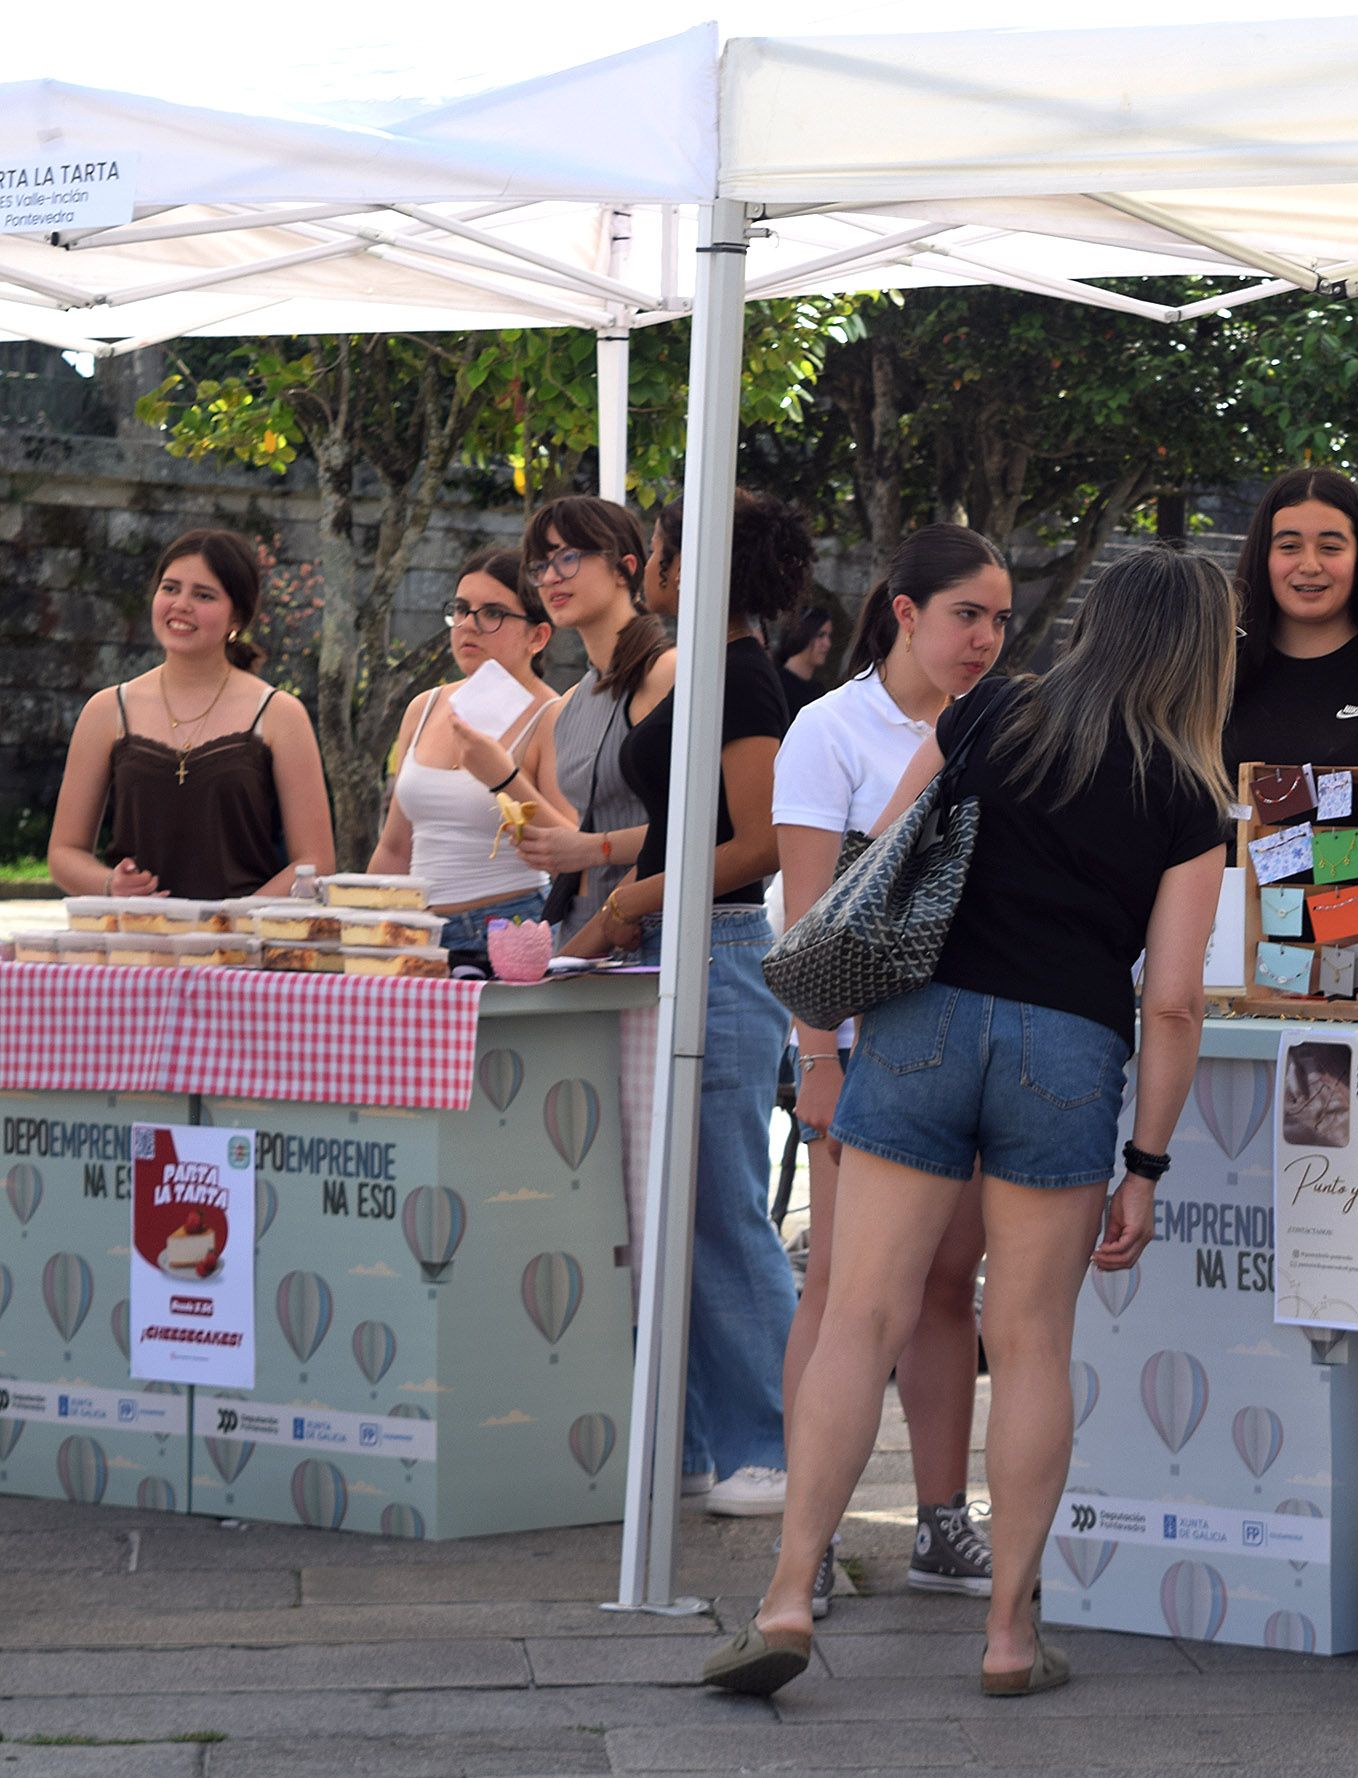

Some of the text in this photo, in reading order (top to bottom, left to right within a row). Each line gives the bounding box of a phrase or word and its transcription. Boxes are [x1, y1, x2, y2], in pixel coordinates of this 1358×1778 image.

[34, 166, 54, 187] LA
[60, 161, 119, 184] TARTA
[16, 188, 89, 207] Valle-Inclán
[4, 210, 74, 227] Pontevedra
[84, 1163, 107, 1199] NA
[163, 1162, 219, 1187] PARTA
[1284, 1154, 1346, 1207] Punto
[153, 1184, 229, 1212] LA TARTA
[323, 1179, 396, 1220] NA ESO
[1197, 1248, 1227, 1290] NA
[1179, 1518, 1209, 1530] XUNTA
[1179, 1528, 1228, 1543] DE GALICIA
[1246, 1525, 1261, 1540] FP
